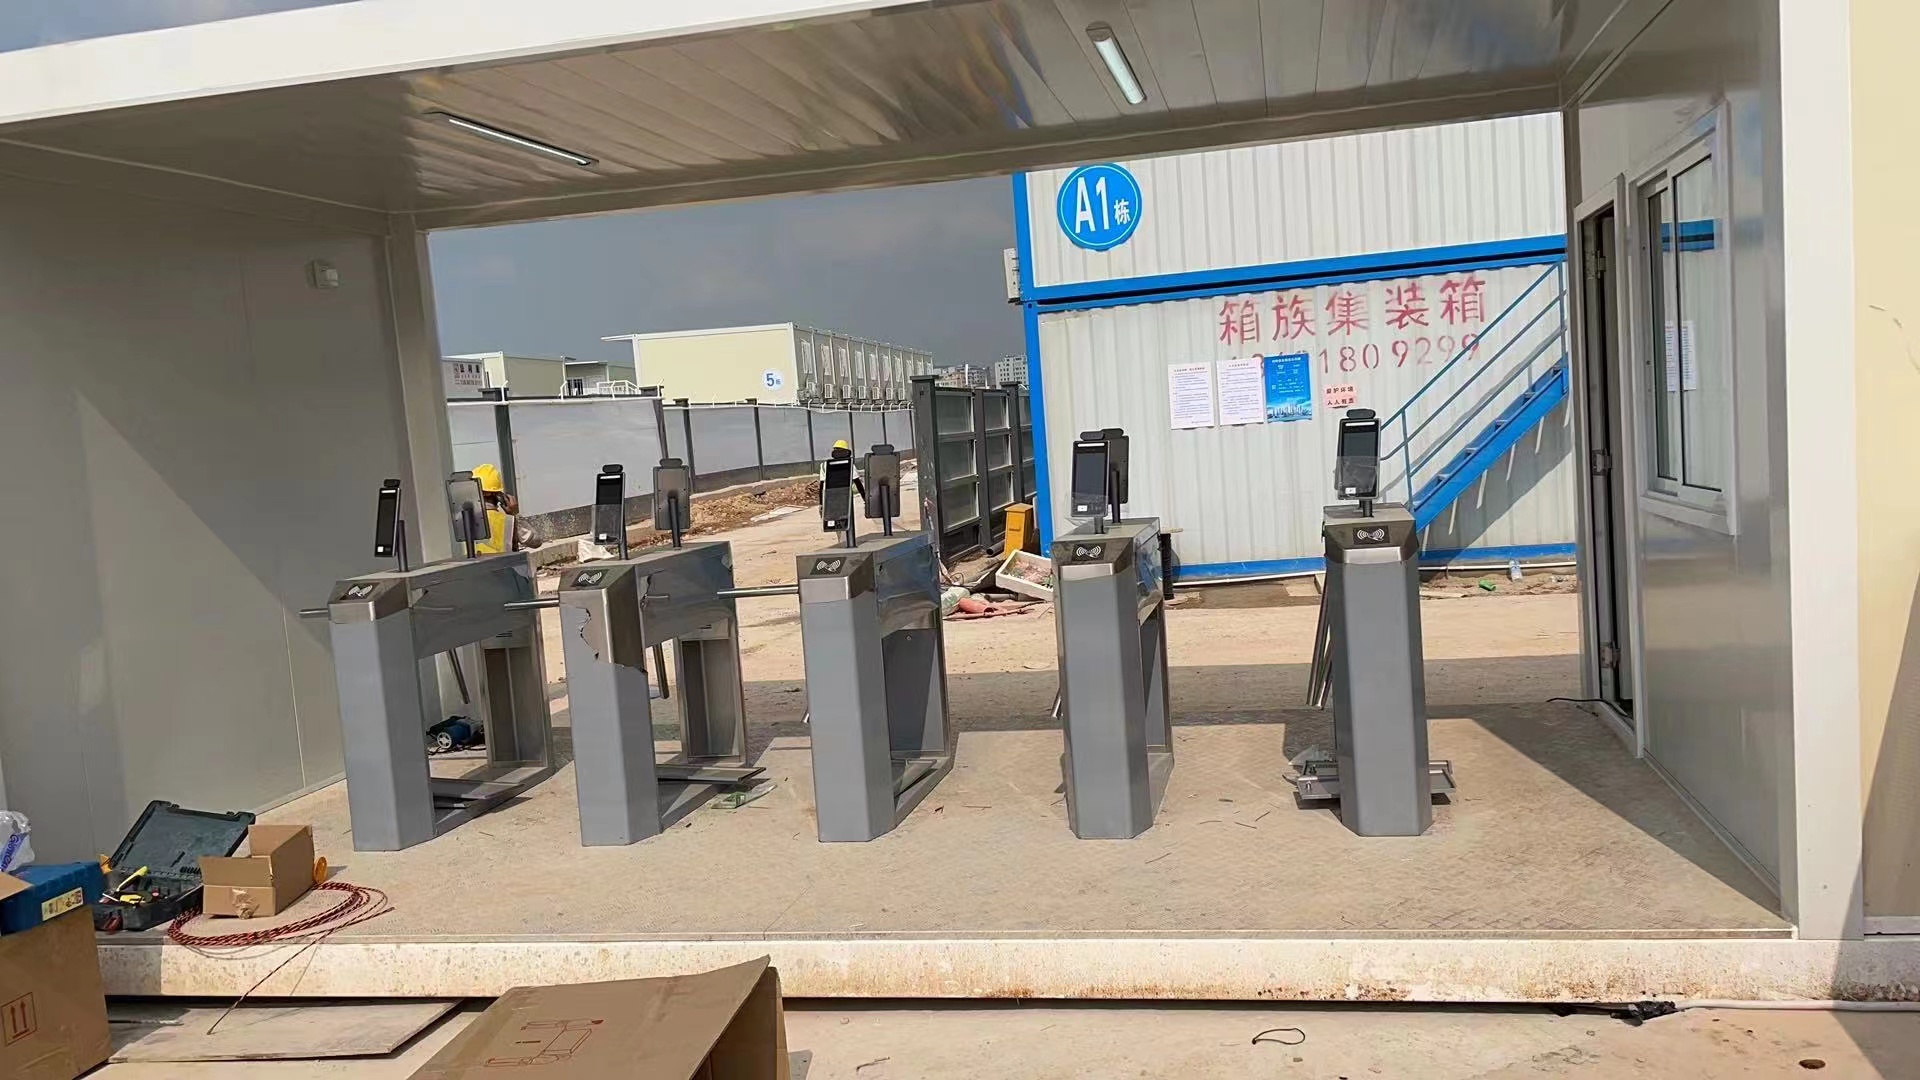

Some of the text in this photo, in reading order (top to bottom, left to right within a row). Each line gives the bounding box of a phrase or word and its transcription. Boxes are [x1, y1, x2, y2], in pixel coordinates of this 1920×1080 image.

[1075, 177, 1131, 233] A1栋
[1219, 276, 1486, 346] 箱族集装箱
